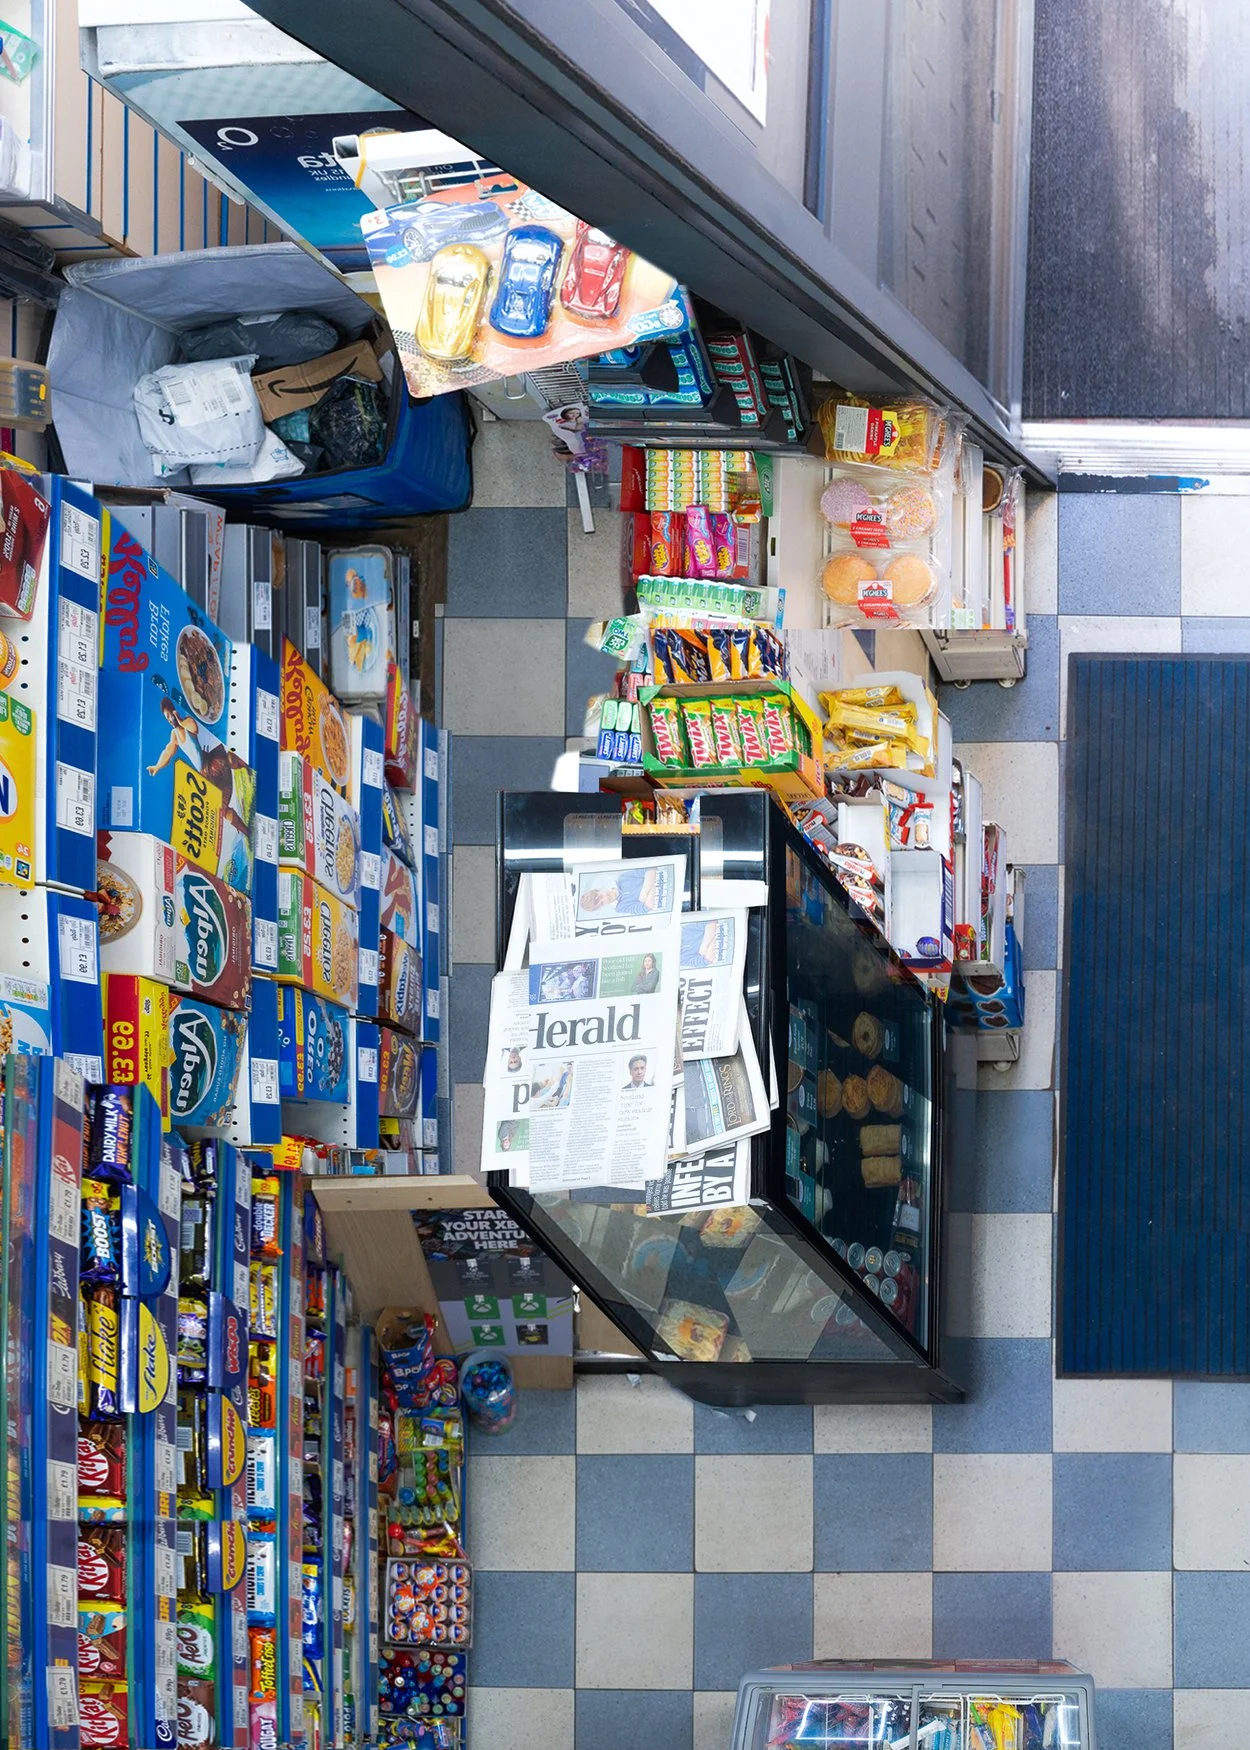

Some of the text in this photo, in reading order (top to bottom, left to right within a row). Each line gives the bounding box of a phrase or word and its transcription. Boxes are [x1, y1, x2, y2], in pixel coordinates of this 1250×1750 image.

[102, 1109, 118, 1164] DAIRY MILK
[90, 1212, 111, 1259] BOOST
[474, 1239, 518, 1250] HERE
[93, 1315, 119, 1378] flake
[141, 1333, 158, 1397] flake
[80, 1698, 119, 1743] KitKat
